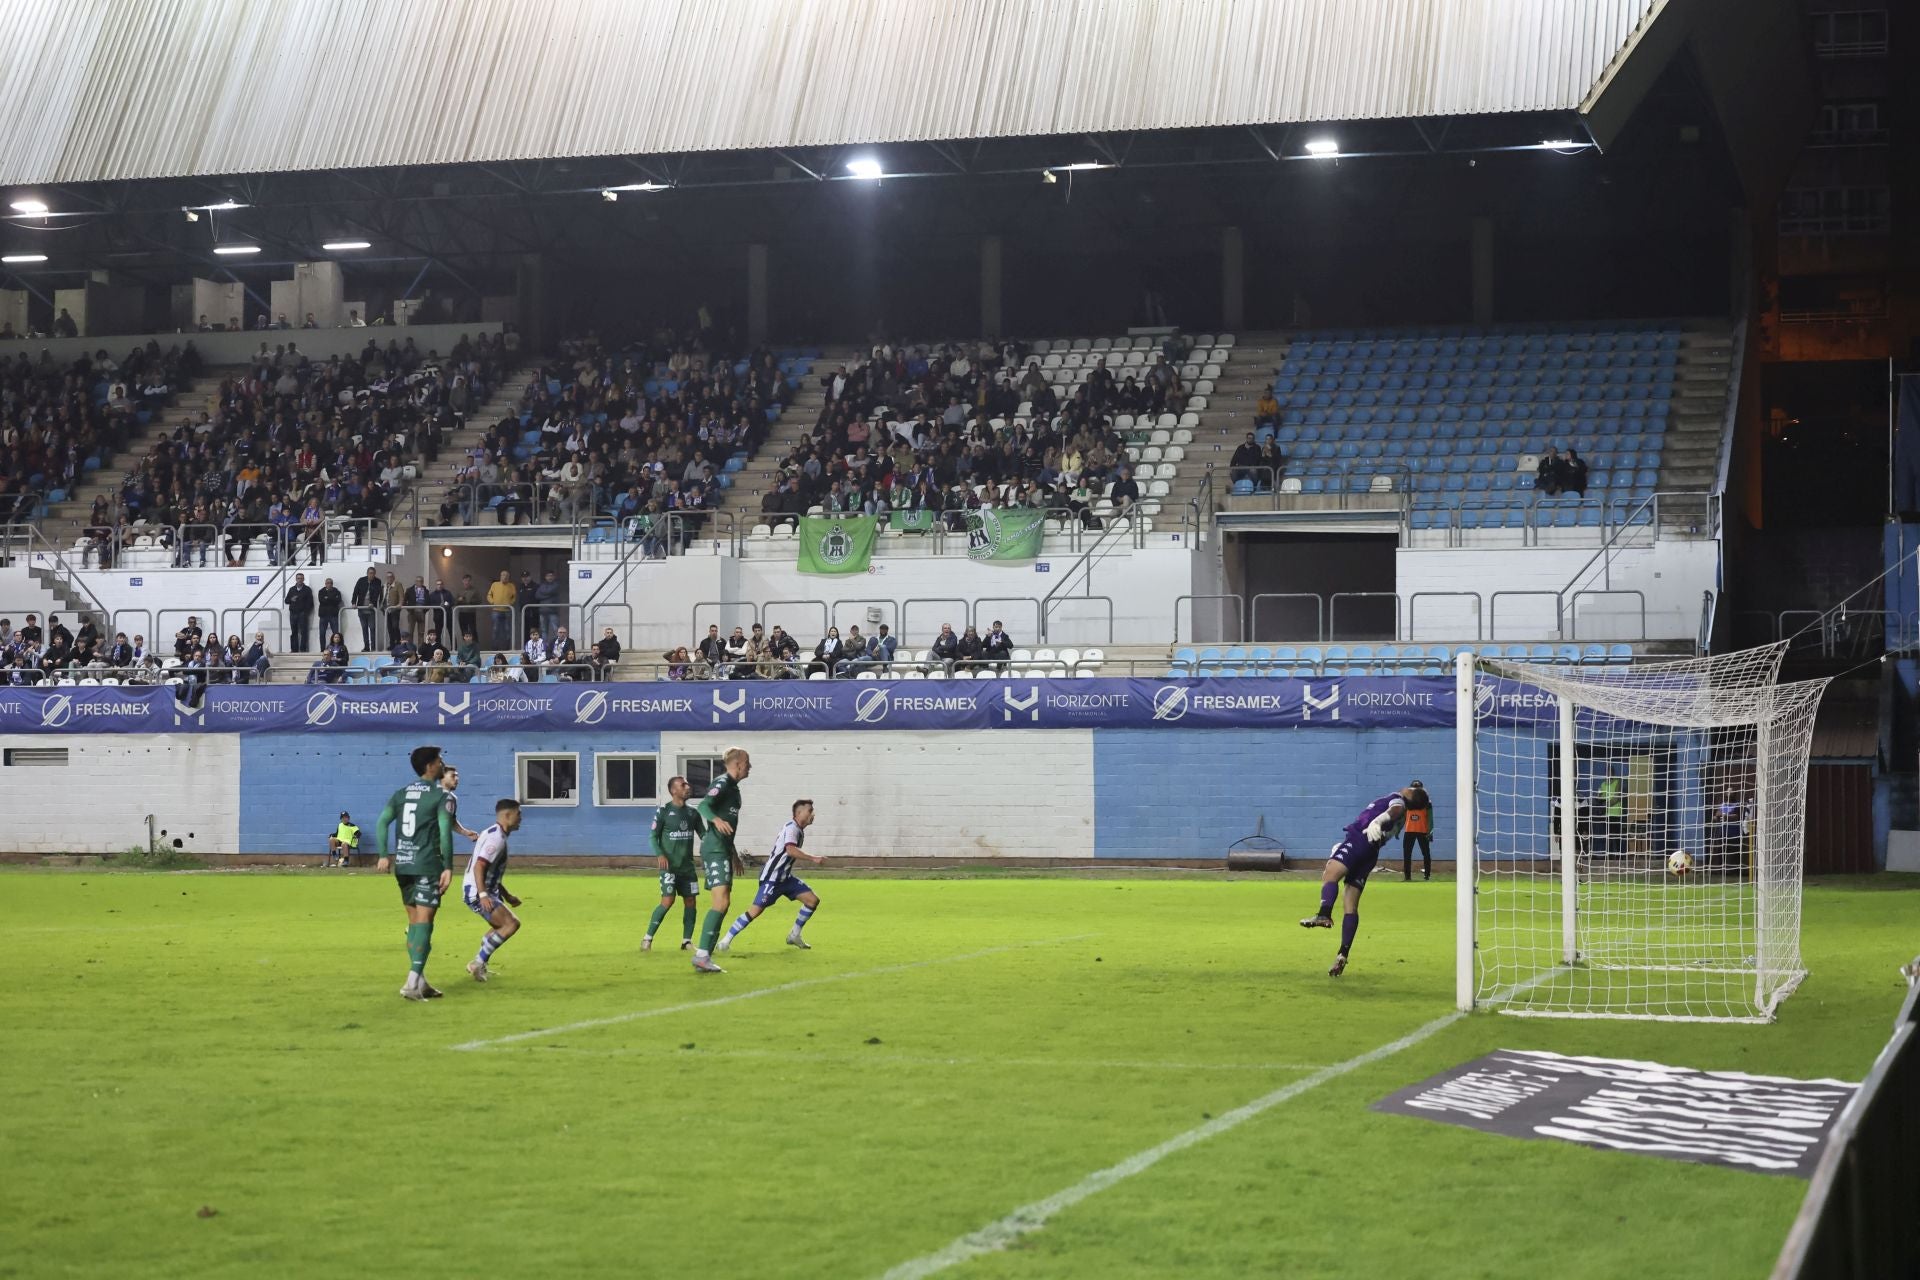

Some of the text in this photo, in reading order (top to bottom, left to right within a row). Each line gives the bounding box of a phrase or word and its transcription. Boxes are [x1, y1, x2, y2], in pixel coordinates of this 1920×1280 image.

[477, 699, 553, 712] HORIZONTE
[612, 699, 692, 713] FRESAMEX
[753, 696, 832, 710] HORIZONTE
[894, 697, 977, 711] FRESAMEX
[1047, 694, 1129, 709] HORIZONTE
[1194, 695, 1281, 709] FRESAMEX
[1347, 692, 1433, 706] HORIZONTE
[76, 703, 150, 716] FRESAMEX
[212, 701, 285, 713] HORIZONTE
[342, 702, 419, 715] FRESAMEX
[401, 802, 418, 838] 5
[664, 872, 676, 884] 22
[763, 883, 774, 895] 14
